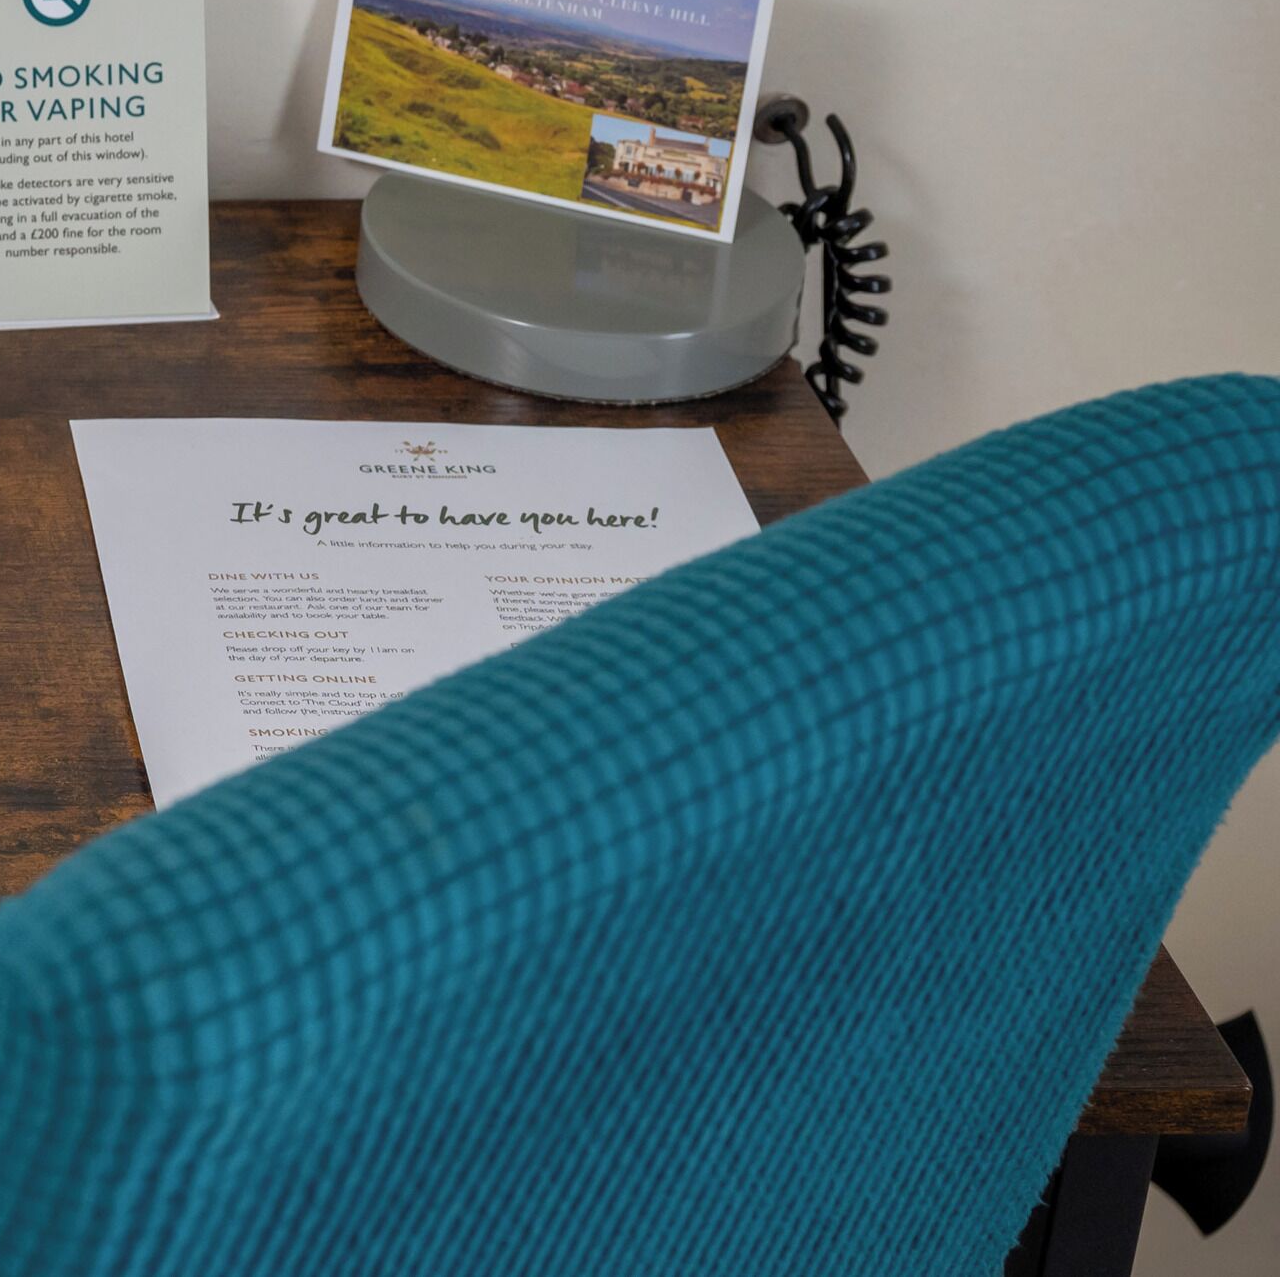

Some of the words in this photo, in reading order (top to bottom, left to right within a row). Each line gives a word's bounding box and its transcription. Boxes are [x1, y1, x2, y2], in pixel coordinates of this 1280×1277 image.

[670, 8, 711, 26] HILL
[14, 62, 163, 89] SMOKING
[27, 96, 146, 121] VAPING
[15, 138, 34, 149] any
[38, 136, 61, 149] part
[65, 133, 79, 144] of
[81, 133, 101, 144] this
[105, 131, 134, 143] hotel
[33, 152, 53, 163] out
[56, 151, 70, 163] of
[72, 150, 91, 161] this
[96, 147, 148, 161] window).
[17, 176, 72, 189] detectors
[76, 177, 94, 187] are
[98, 176, 122, 188] very
[126, 173, 174, 184] sensitive
[12, 194, 63, 206] activated
[67, 193, 80, 206] by
[84, 192, 133, 206] cigarette
[17, 212, 27, 223] in
[31, 215, 37, 223] a
[41, 211, 58, 223] full
[61, 209, 122, 221] evacuation
[125, 207, 138, 219] of
[141, 207, 159, 218] the
[20, 232, 26, 240] a
[31, 228, 59, 240] £200
[63, 227, 84, 238] fine
[87, 226, 104, 237] for
[108, 225, 126, 236] the
[130, 226, 162, 236] room
[5, 246, 50, 258] number
[53, 243, 121, 257] responsible.
[359, 464, 439, 475] GREENE
[445, 464, 497, 475] KING
[230, 501, 293, 524] It's
[303, 502, 390, 535] great
[394, 505, 430, 525] to
[439, 505, 511, 526] have
[520, 511, 579, 534] you
[587, 507, 659, 528] here!
[330, 539, 355, 548] little
[358, 540, 426, 549] information
[429, 541, 442, 549] to
[445, 542, 471, 551] help
[475, 543, 496, 551] you
[499, 542, 538, 552] during
[540, 543, 566, 551] your
[208, 573, 247, 581] DINE
[250, 573, 295, 581] WITH
[484, 575, 529, 584] YOUR
[533, 576, 605, 584] OPINION
[223, 630, 310, 639] CHECKING
[314, 631, 349, 639] OUT
[226, 646, 258, 654] Please
[261, 645, 286, 655] drop
[289, 645, 304, 653] off
[307, 647, 330, 655] your
[332, 646, 350, 655] key
[353, 646, 366, 655] by
[228, 654, 245, 662] the
[248, 654, 266, 663] day
[269, 654, 281, 662] of
[283, 655, 306, 663] your
[234, 674, 308, 683] GETTING
[312, 675, 377, 684] ONLINE
[249, 728, 329, 737] SMOKING
